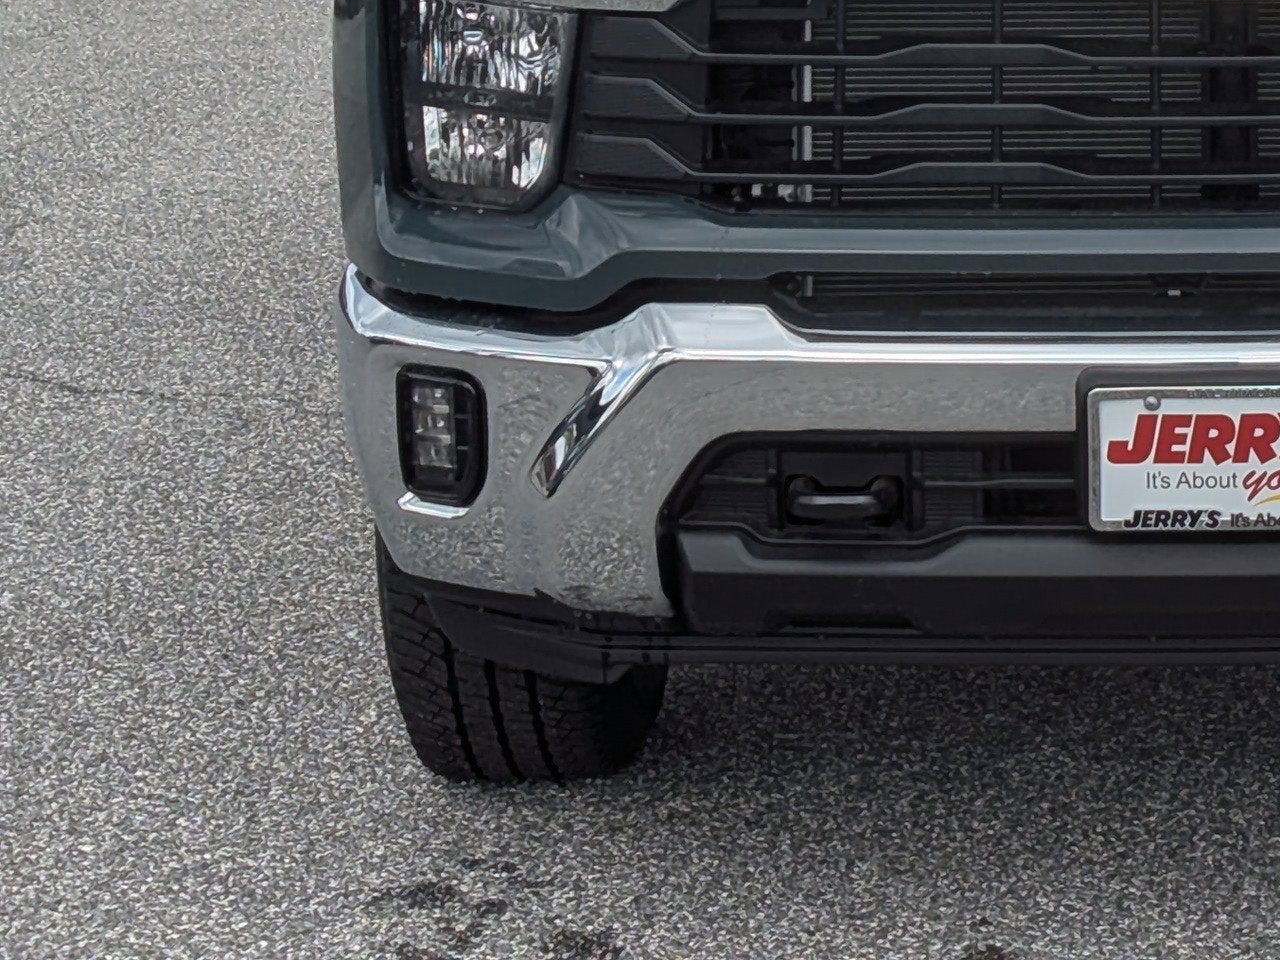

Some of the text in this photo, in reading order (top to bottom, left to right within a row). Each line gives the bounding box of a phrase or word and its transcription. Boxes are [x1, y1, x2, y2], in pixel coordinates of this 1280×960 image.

[1146, 471, 1171, 490] It's
[1176, 470, 1238, 490] About
[1123, 509, 1222, 529] JERRY'S
[1230, 513, 1251, 528] It's
